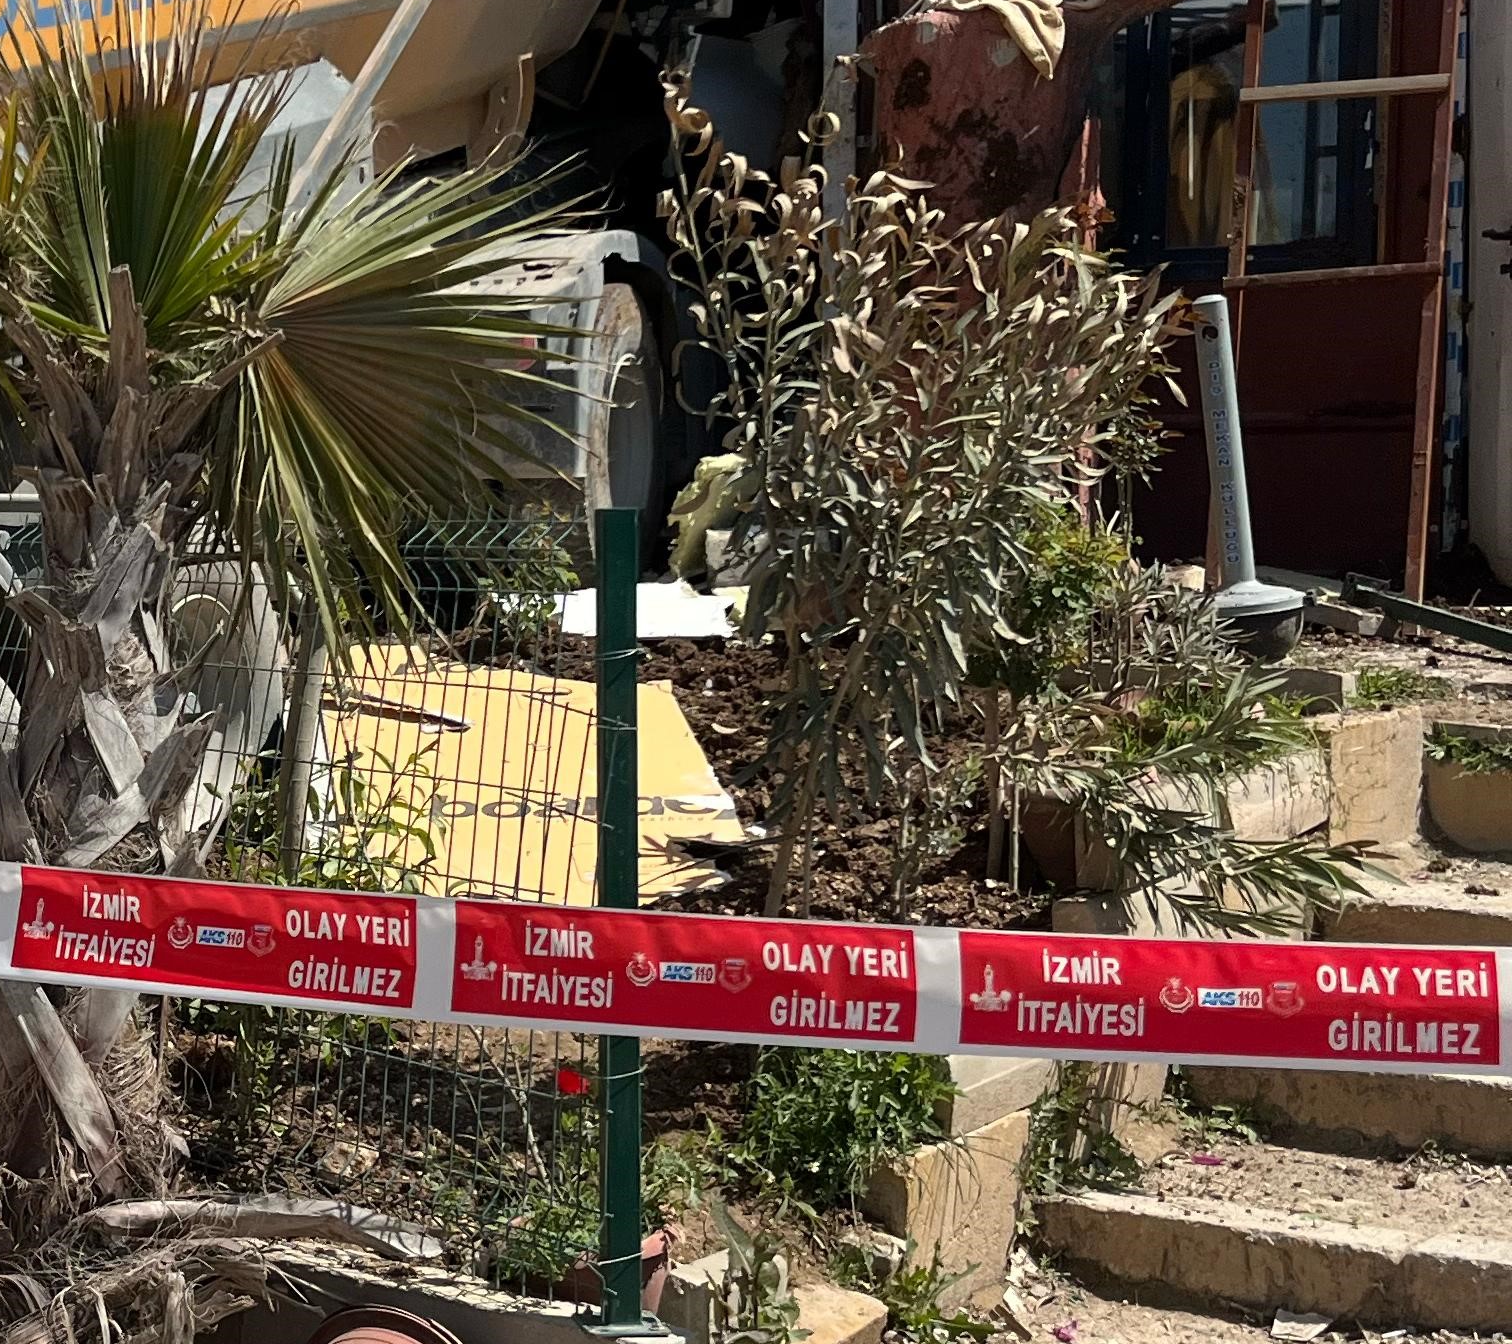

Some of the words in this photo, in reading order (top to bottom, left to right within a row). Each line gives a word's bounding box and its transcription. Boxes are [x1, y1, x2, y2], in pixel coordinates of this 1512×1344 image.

[83, 884, 140, 923] İZMİR
[55, 924, 155, 968] İTFAİYESİ
[286, 909, 347, 941] OLAY
[356, 910, 410, 947] YERİ
[525, 920, 594, 959] İZMİR
[288, 954, 402, 998] GİRİLMEZ
[762, 941, 835, 975] OLAY
[844, 941, 908, 979] YERİ
[1043, 948, 1121, 985] İZMİR
[1316, 964, 1402, 997] OLAY
[1413, 961, 1488, 999] YERİ
[501, 963, 613, 1009] İTFAİYESİ
[770, 989, 900, 1033] GİRİLMEZ
[1017, 992, 1144, 1037] İTFAİYESİ
[1328, 1013, 1481, 1056] GİRİLMEZ
